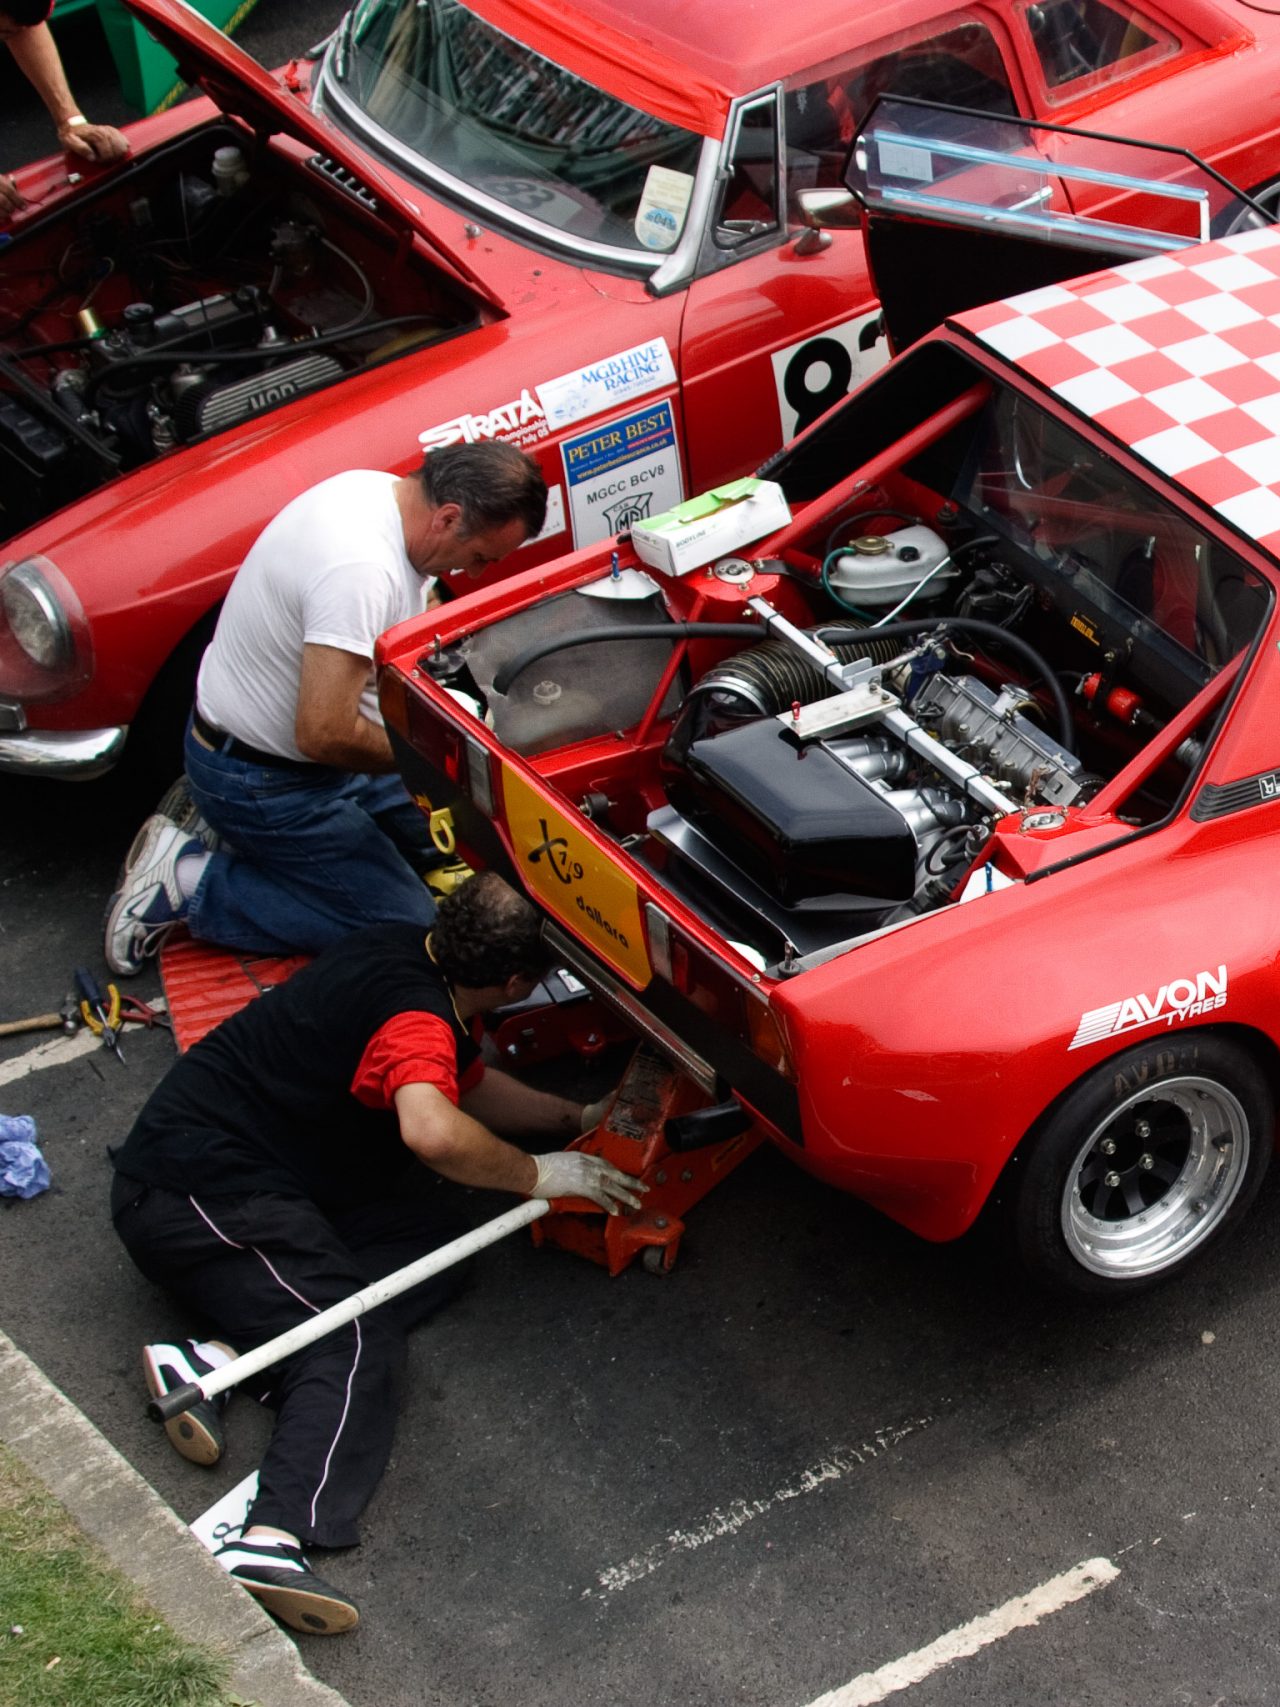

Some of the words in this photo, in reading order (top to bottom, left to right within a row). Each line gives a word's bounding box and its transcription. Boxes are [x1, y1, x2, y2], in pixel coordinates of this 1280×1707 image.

[604, 360, 661, 392] RACING
[418, 388, 546, 453] STRATA
[567, 431, 623, 464] PETER
[625, 410, 668, 441] BEST
[586, 481, 626, 505] MGCC
[630, 464, 665, 487] BCV8
[575, 896, 629, 949] dallara
[1112, 964, 1228, 1033] AVON
[1164, 991, 1228, 1026] TYRES
